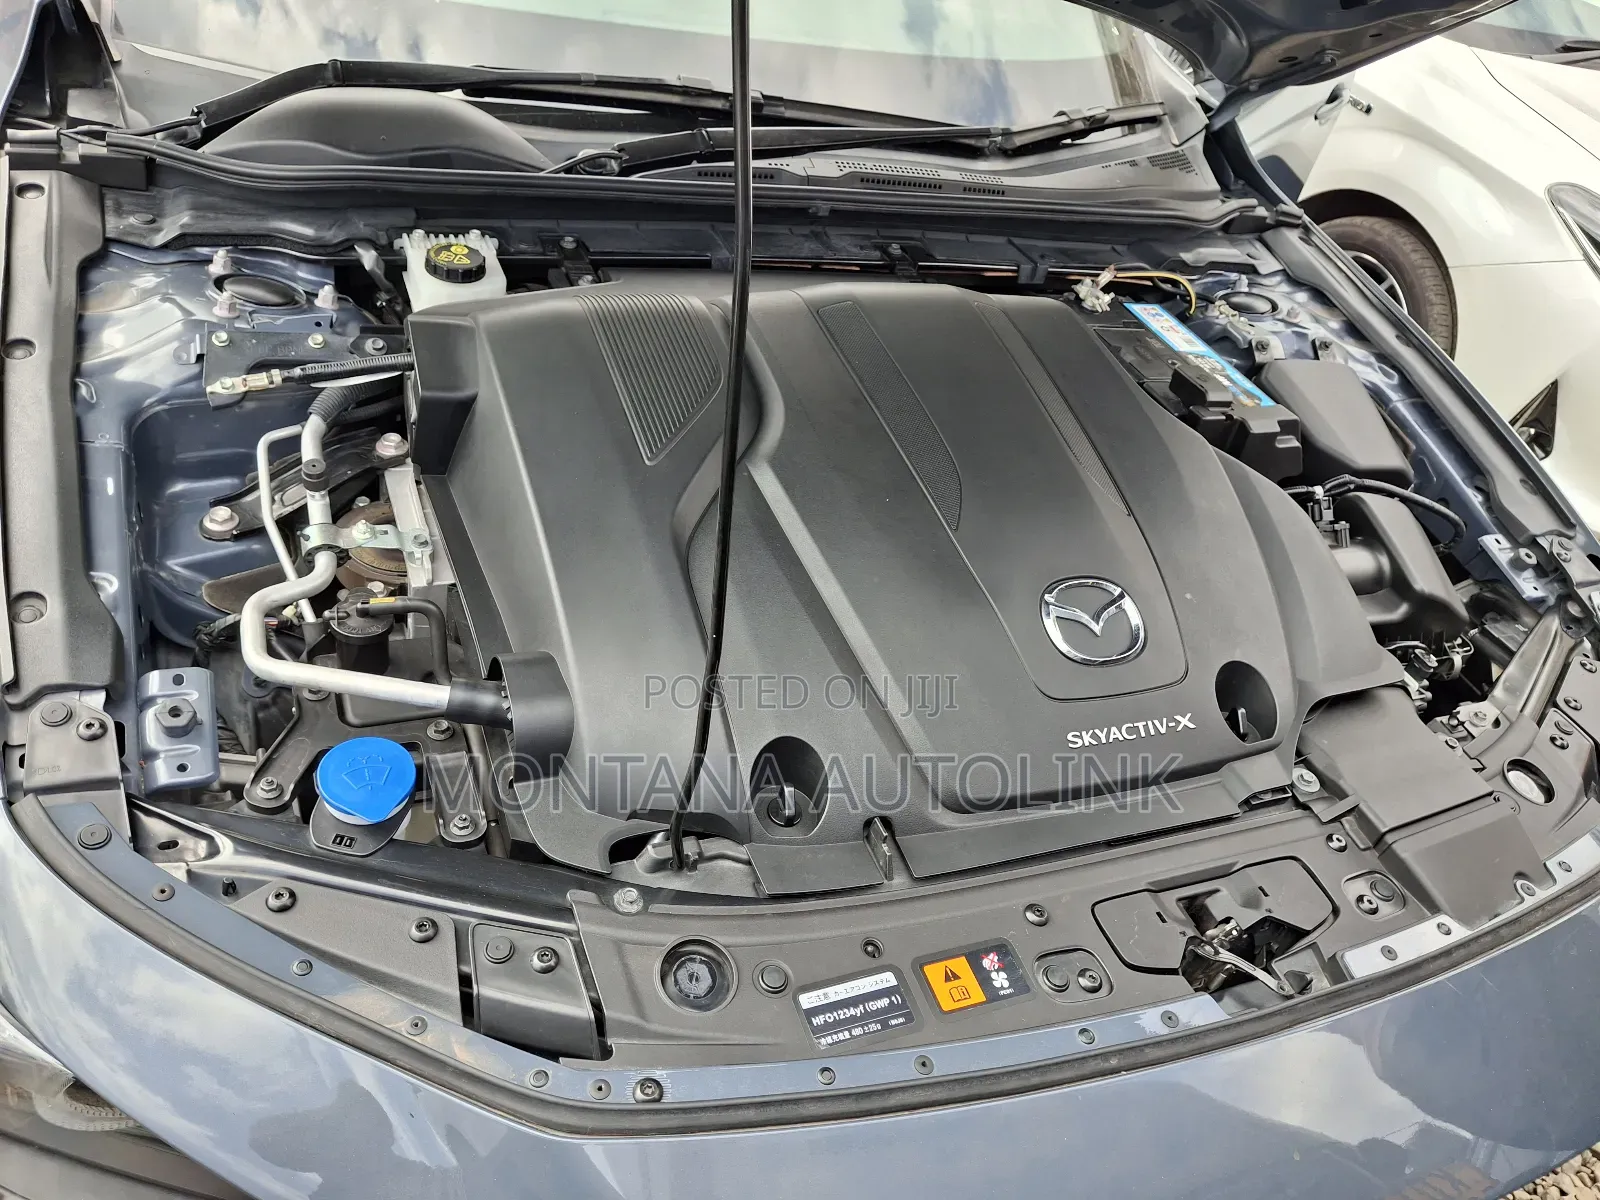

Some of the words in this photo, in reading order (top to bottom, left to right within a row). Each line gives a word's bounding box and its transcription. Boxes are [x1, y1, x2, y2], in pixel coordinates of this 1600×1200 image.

[1066, 713, 1197, 749] SKYACTIV-X
[811, 1005, 865, 1027] HFO1234yf
[865, 997, 890, 1013] (GWP
